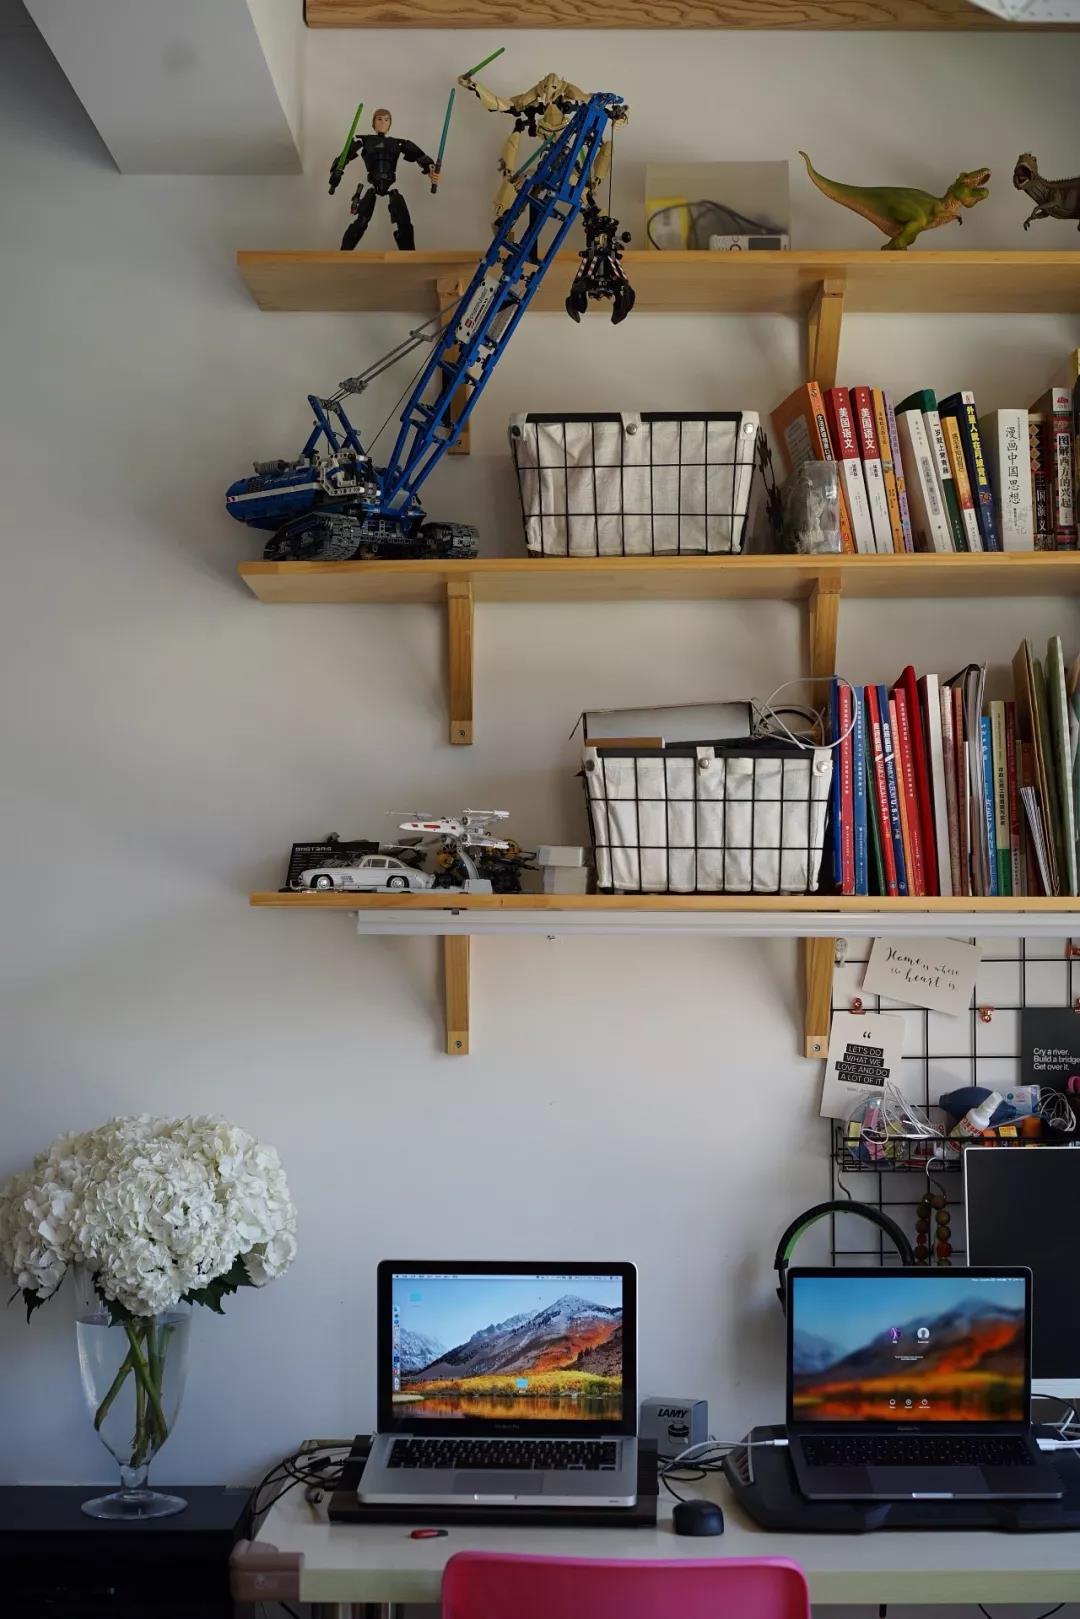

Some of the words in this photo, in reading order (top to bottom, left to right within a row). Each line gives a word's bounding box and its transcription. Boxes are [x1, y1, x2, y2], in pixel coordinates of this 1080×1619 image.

[838, 407, 854, 449] 美国语文
[860, 407, 876, 449] 美国语文
[1006, 426, 1021, 504] 漫画中国思想
[1058, 435, 1073, 508] 图解西方的兴起
[886, 946, 921, 966] Home
[934, 964, 960, 976] where
[905, 968, 941, 988] heart
[848, 1045, 868, 1055] LET'S
[869, 1048, 882, 1056] DO
[1033, 1047, 1046, 1056] Cry
[846, 1055, 868, 1064] WHAT
[869, 1058, 882, 1067] WE
[837, 1063, 857, 1072] LOVE
[858, 1066, 875, 1075] AND
[876, 1069, 888, 1077] DO
[847, 1074, 862, 1082] LOT
[657, 1408, 689, 1418] LAMY
